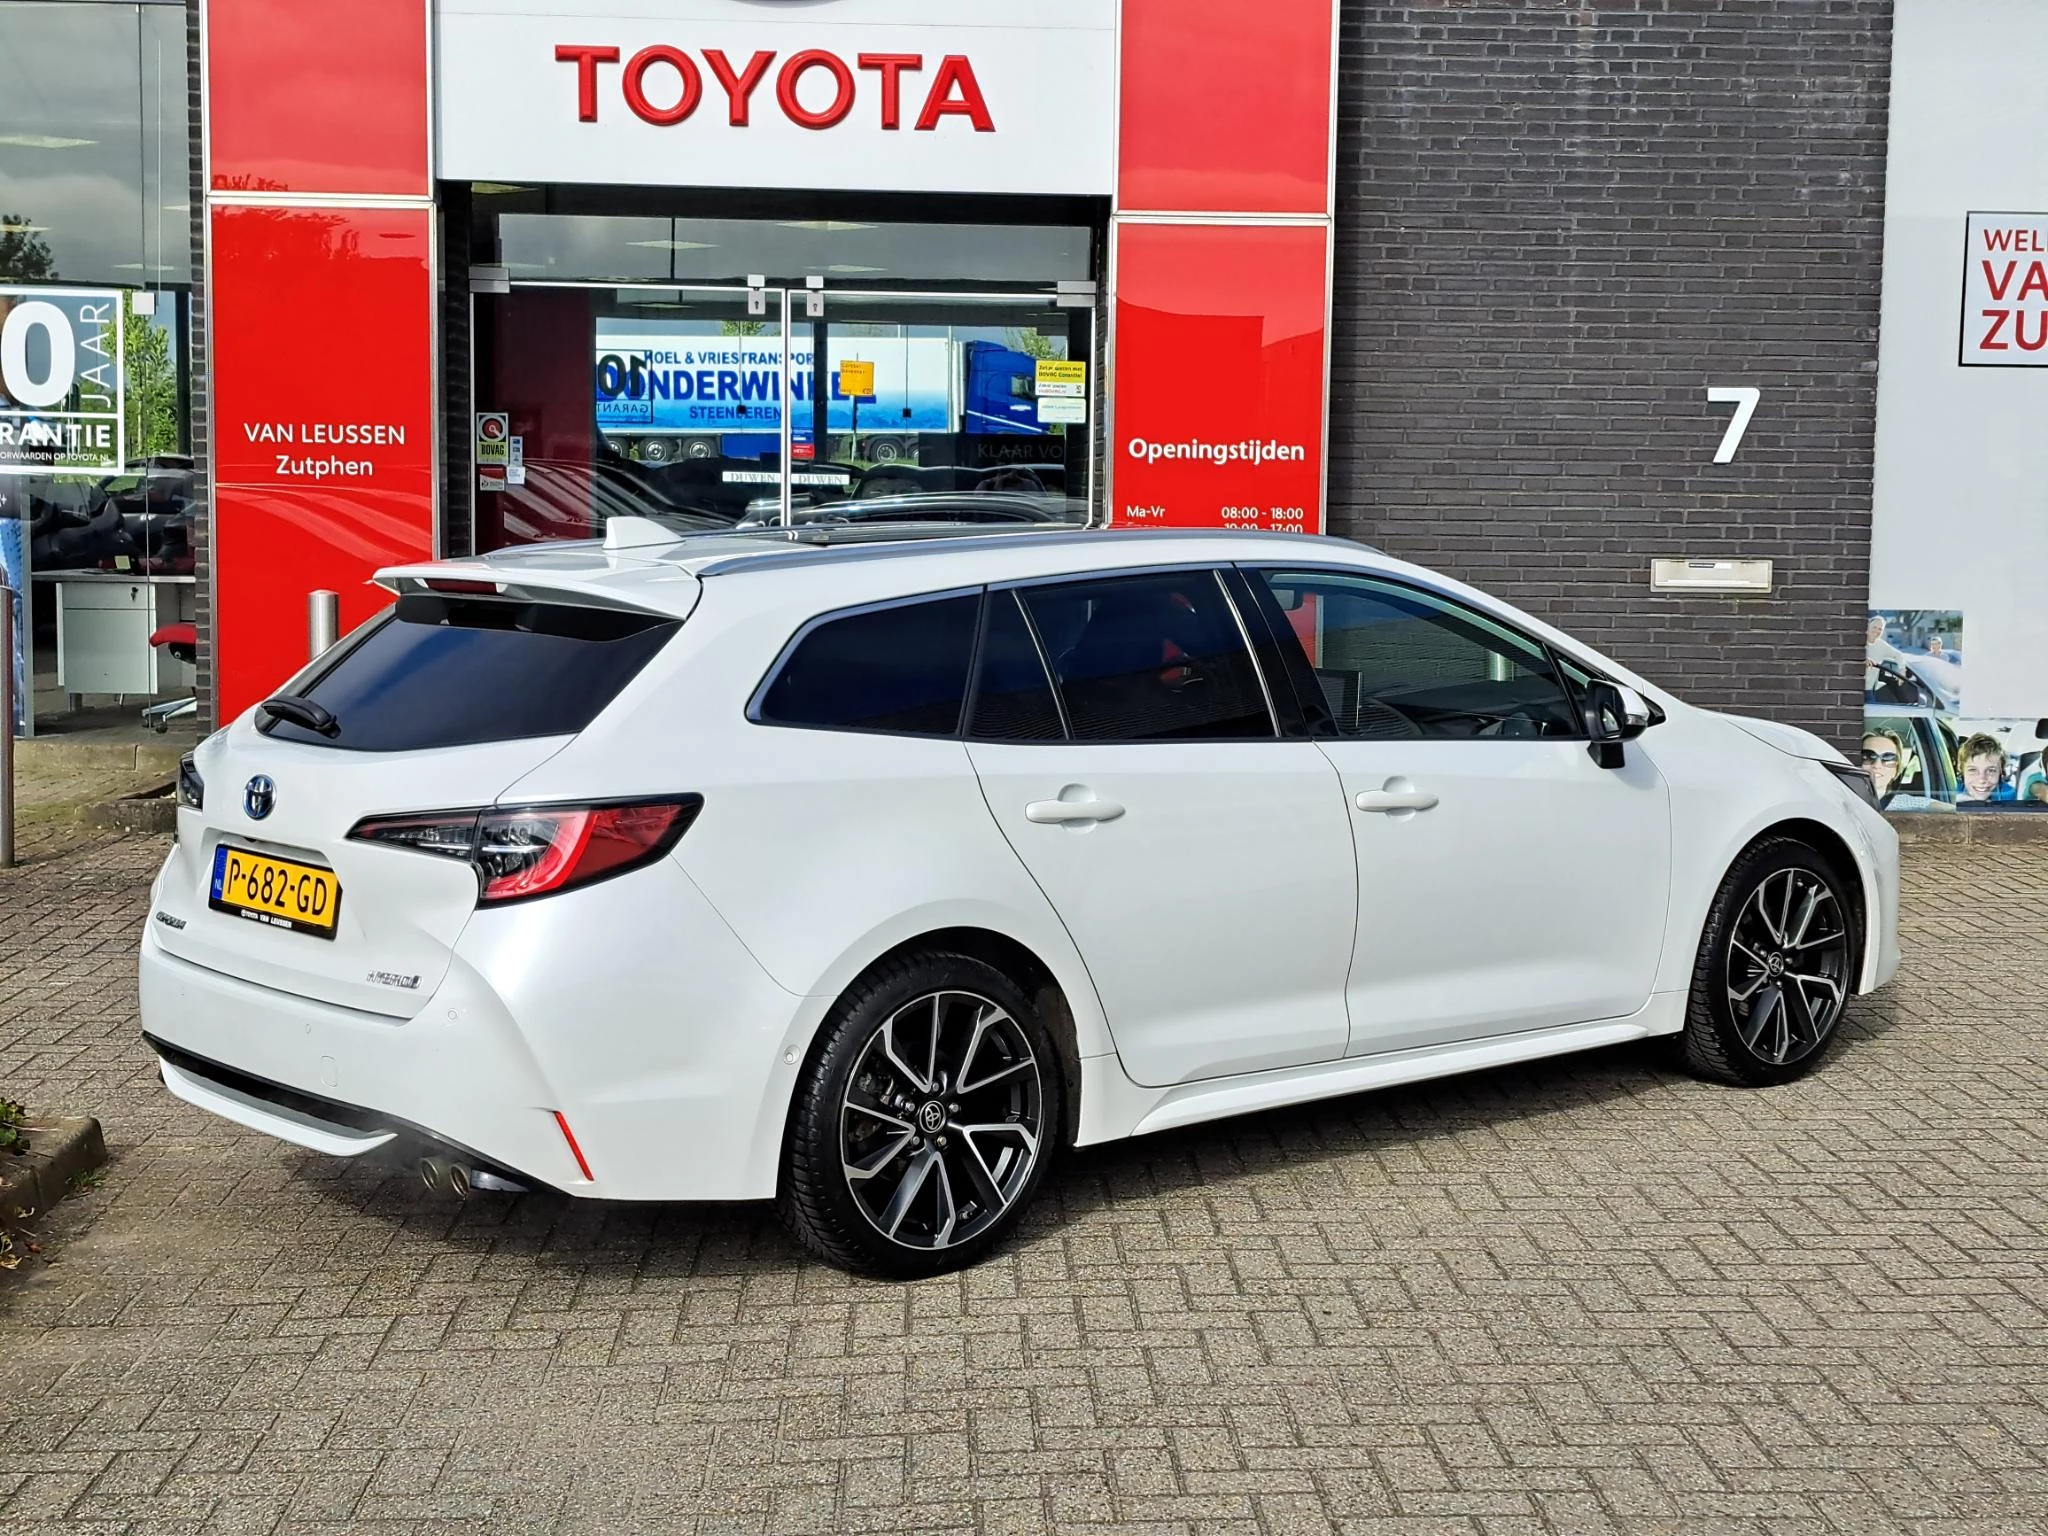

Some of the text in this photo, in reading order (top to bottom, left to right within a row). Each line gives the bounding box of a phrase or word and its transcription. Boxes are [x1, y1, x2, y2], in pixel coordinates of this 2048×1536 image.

[555, 44, 996, 132] TOYOTA
[1983, 229, 2048, 251] WEL
[80, 303, 111, 408] JAAR
[685, 352, 694, 364] &
[243, 423, 405, 445] VAN LEUSSEN
[1707, 387, 1761, 463] 7
[54, 453, 65, 461] OP
[480, 444, 505, 456] BOVAG
[977, 444, 1033, 459] KLAAR
[1128, 438, 1305, 466] Openingstijden
[275, 455, 373, 480] Zutphen
[1126, 504, 1166, 518] Ma-Vr
[1221, 506, 1258, 519] 08:00
[1270, 507, 1304, 520] 18:00
[214, 879, 222, 890] NL
[228, 858, 328, 917] P-682-GD
